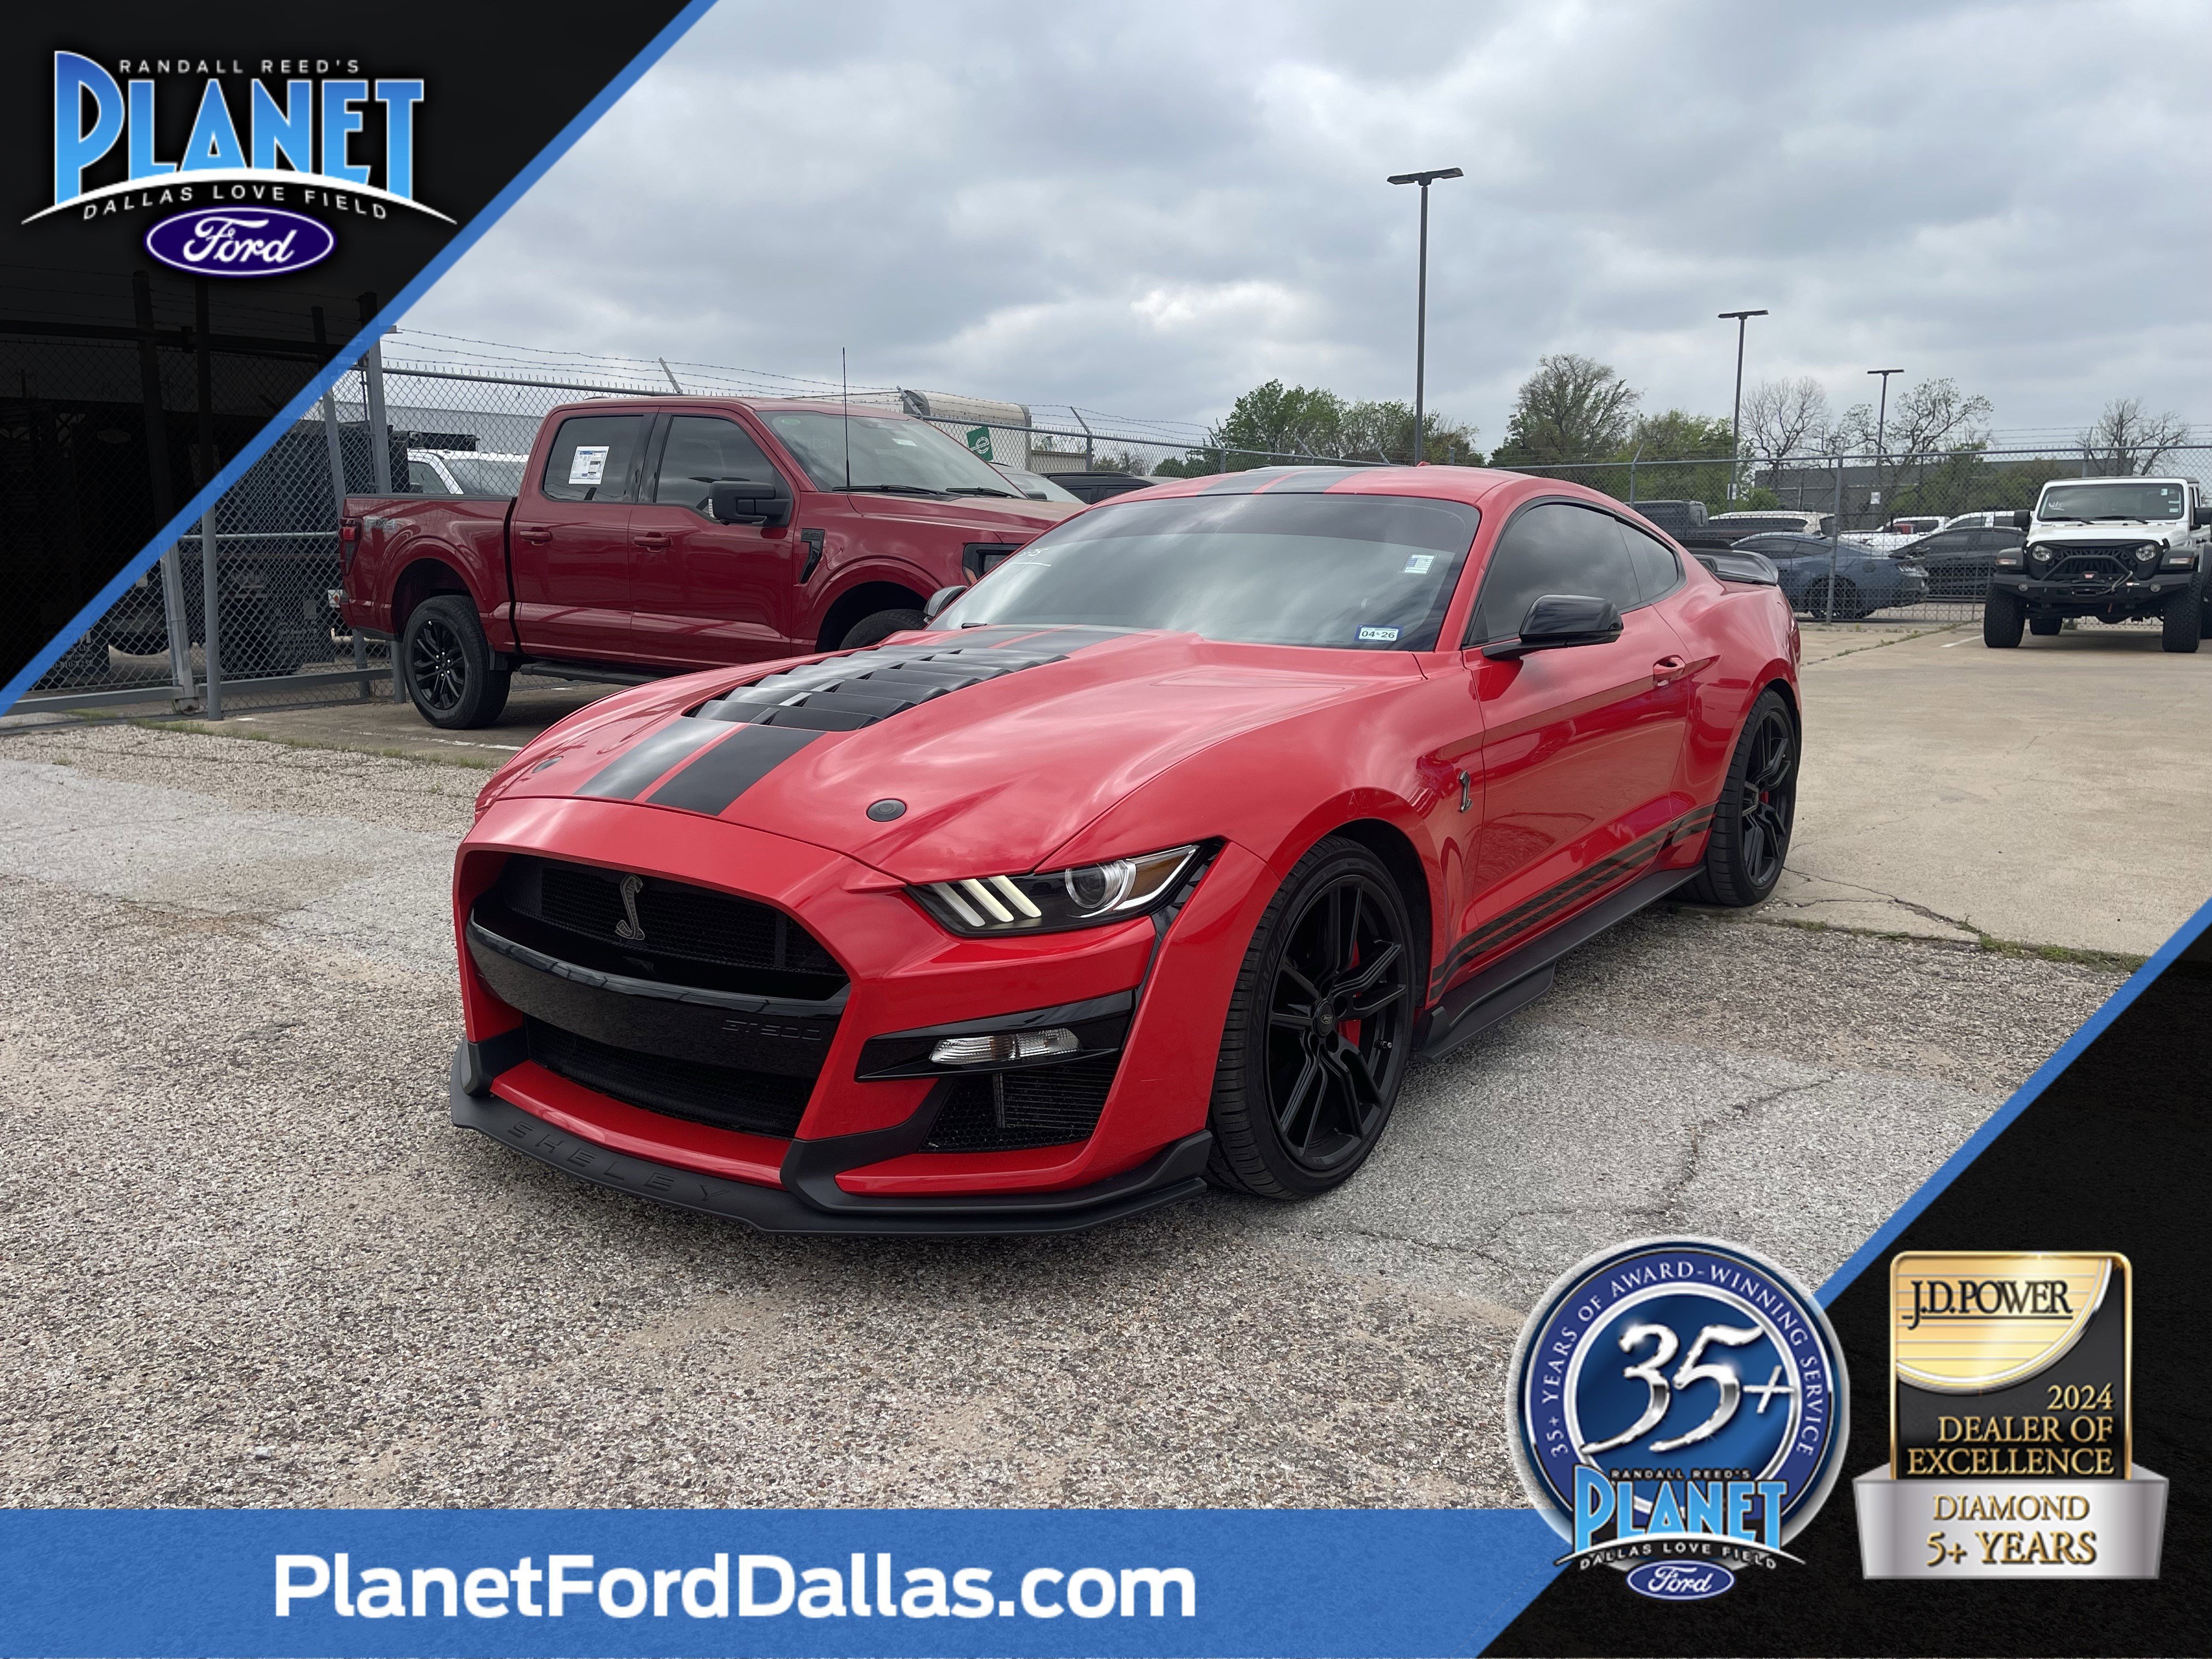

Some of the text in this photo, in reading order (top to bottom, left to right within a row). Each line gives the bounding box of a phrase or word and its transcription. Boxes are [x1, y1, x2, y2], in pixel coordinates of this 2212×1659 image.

[365, 518, 396, 531] FX4
[721, 1019, 822, 1041] GT500
[507, 1120, 730, 1202] SHELBY
